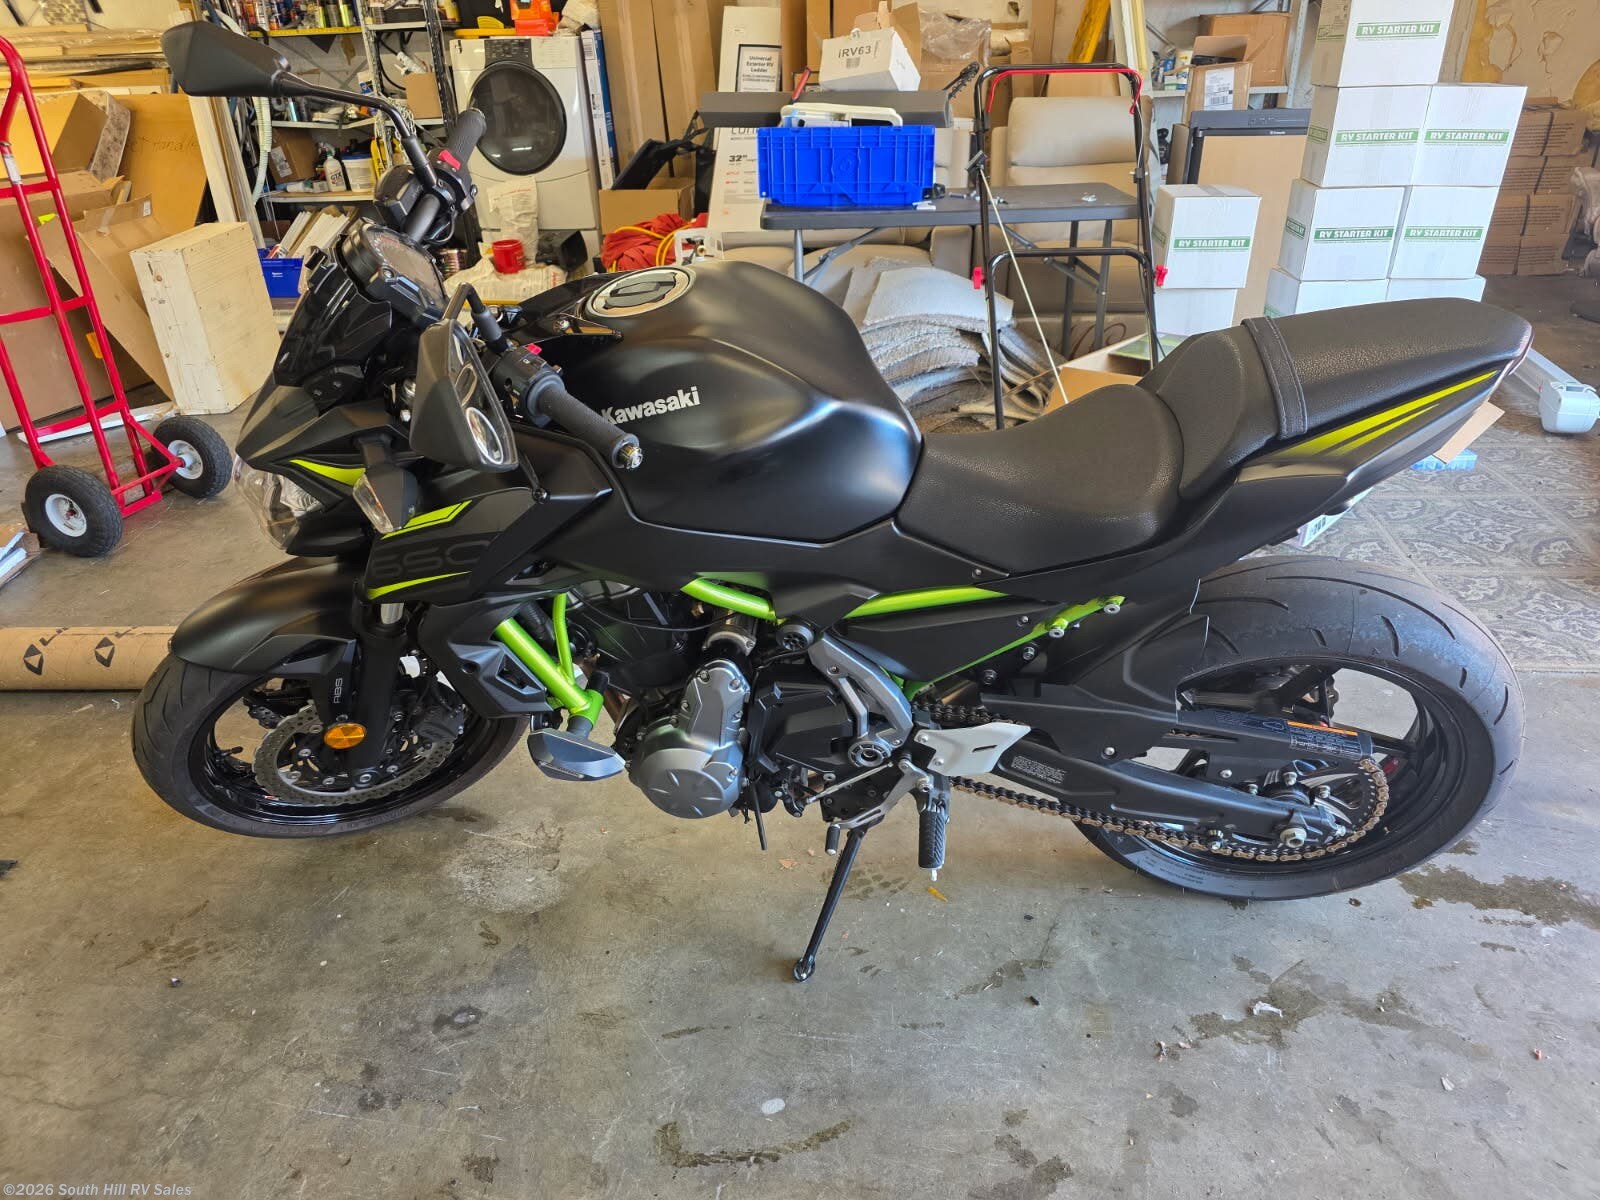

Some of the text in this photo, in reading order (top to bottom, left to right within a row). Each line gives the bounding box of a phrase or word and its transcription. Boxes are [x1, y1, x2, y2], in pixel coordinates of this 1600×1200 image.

[1362, 24, 1435, 35] RV STARTER KIT
[838, 45, 872, 58] iRV63
[1341, 131, 1414, 141] RV STARTER KIT
[1430, 132, 1505, 141] RV STARTER KIT
[1319, 229, 1389, 238] RV STARTER KIT
[1410, 229, 1478, 237] RV STARTER KIT
[1178, 239, 1246, 248] RV STARTER KIT
[601, 385, 701, 425] Kawasaki
[333, 677, 343, 703] ABS
